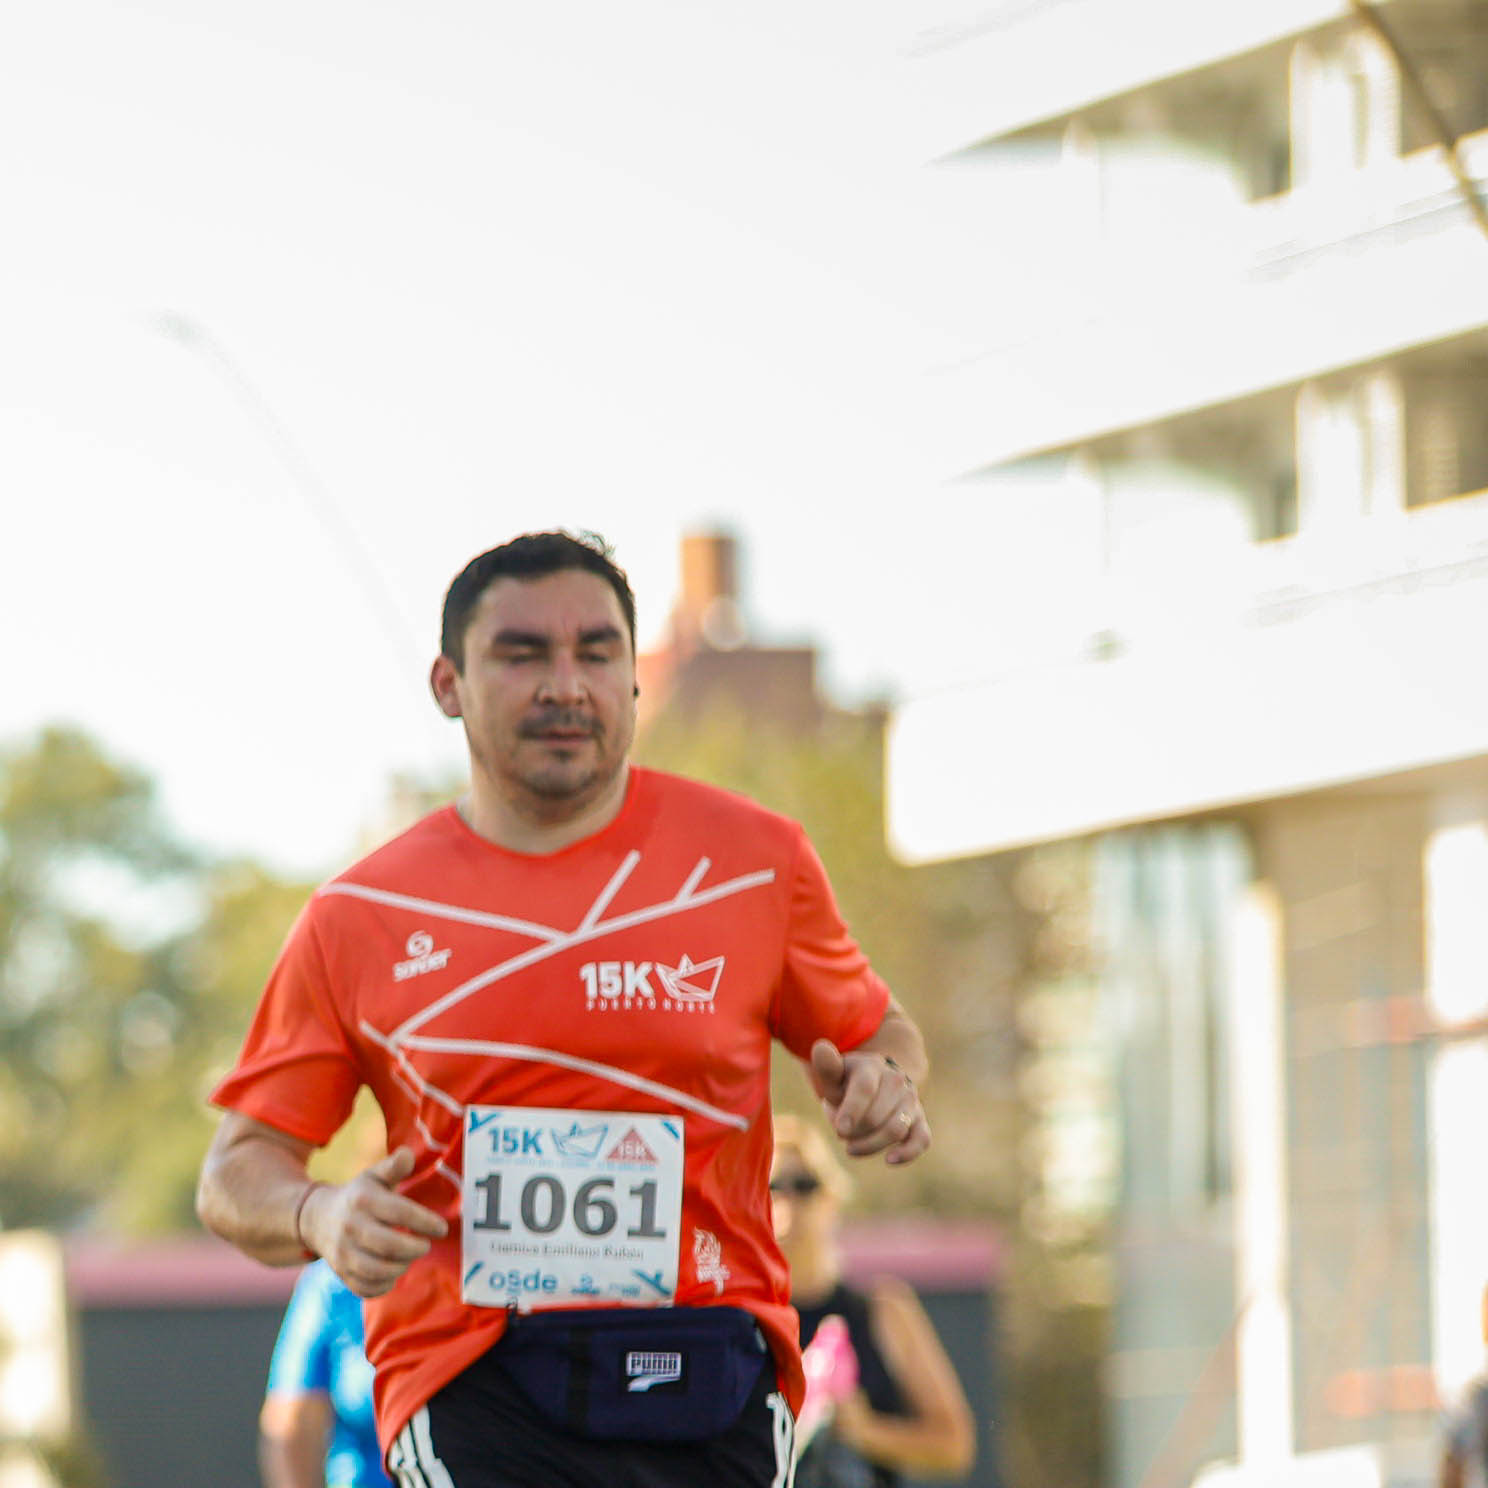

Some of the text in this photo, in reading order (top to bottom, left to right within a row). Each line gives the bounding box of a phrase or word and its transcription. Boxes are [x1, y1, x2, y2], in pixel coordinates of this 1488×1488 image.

[579, 960, 655, 999] 15K
[488, 1126, 544, 1155] 15K
[473, 1172, 667, 1239] 1061
[489, 1268, 558, 1295] osde
